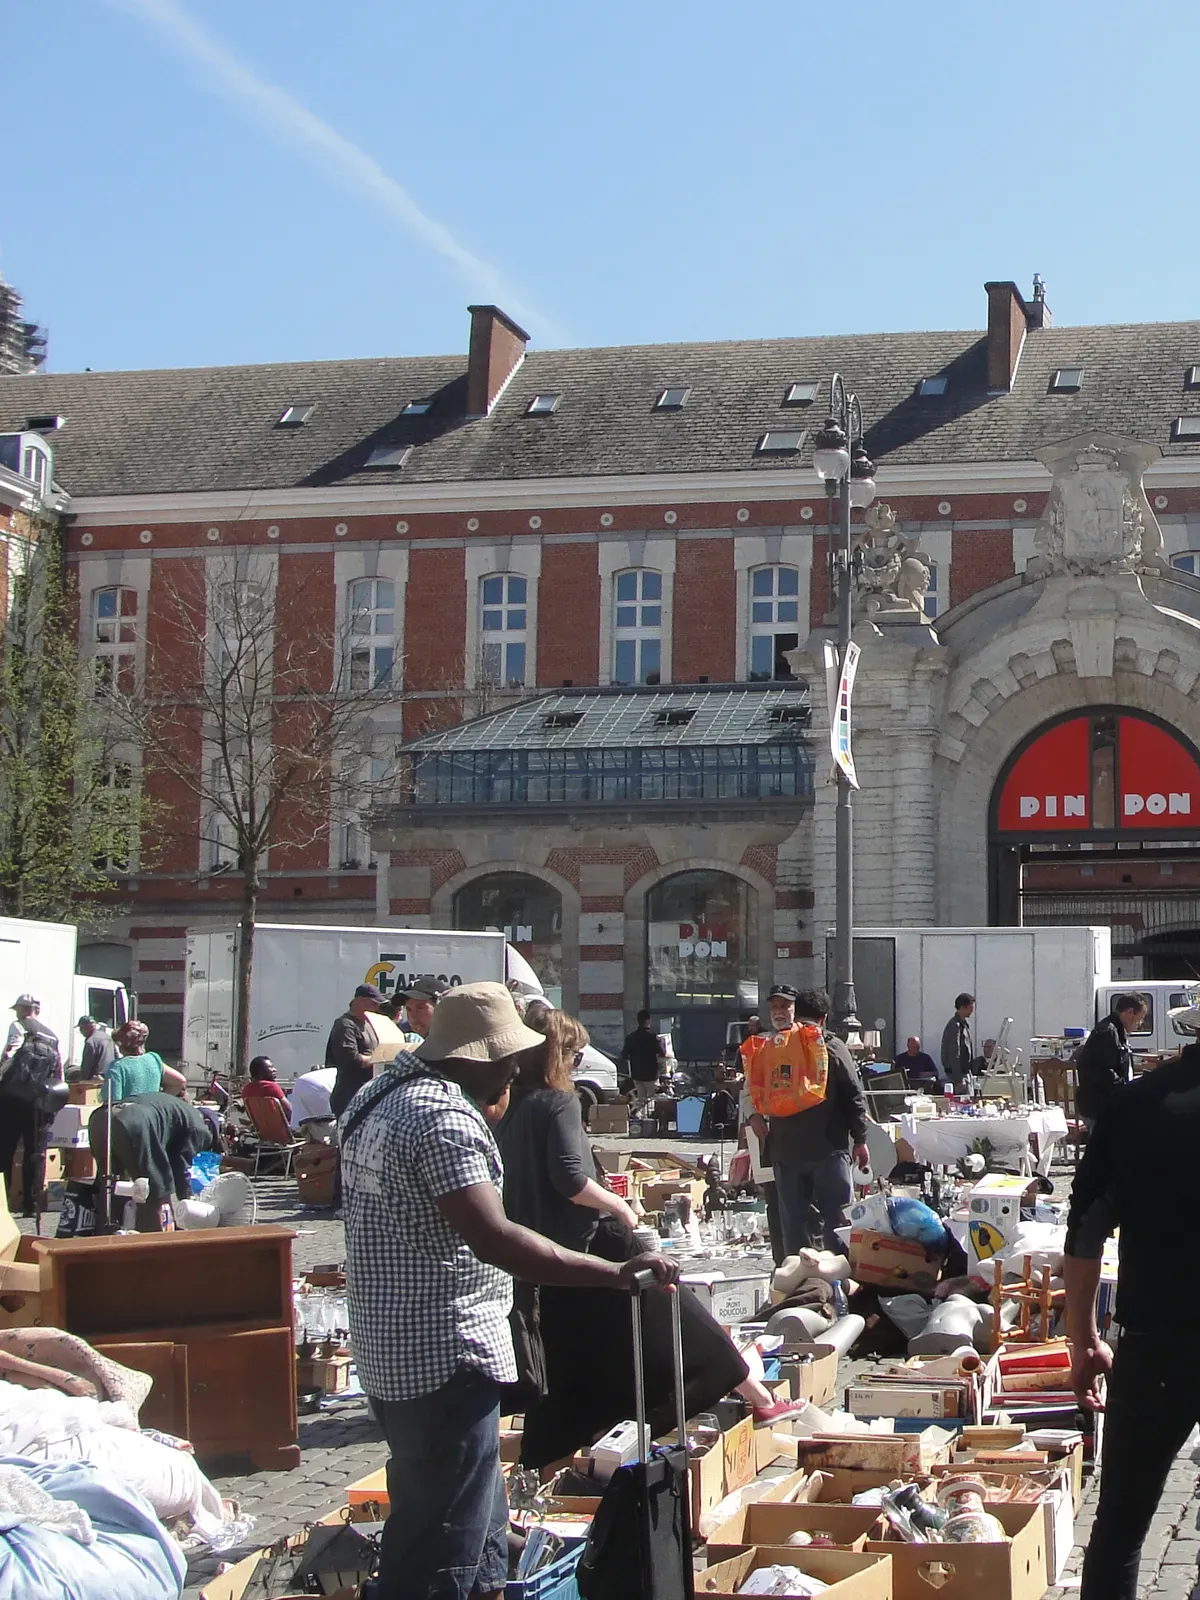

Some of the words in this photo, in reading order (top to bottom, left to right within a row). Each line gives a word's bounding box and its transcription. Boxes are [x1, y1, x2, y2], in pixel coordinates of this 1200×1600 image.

[1020, 795, 1085, 818] PIN
[1124, 793, 1191, 815] PON
[679, 941, 727, 958] PON
